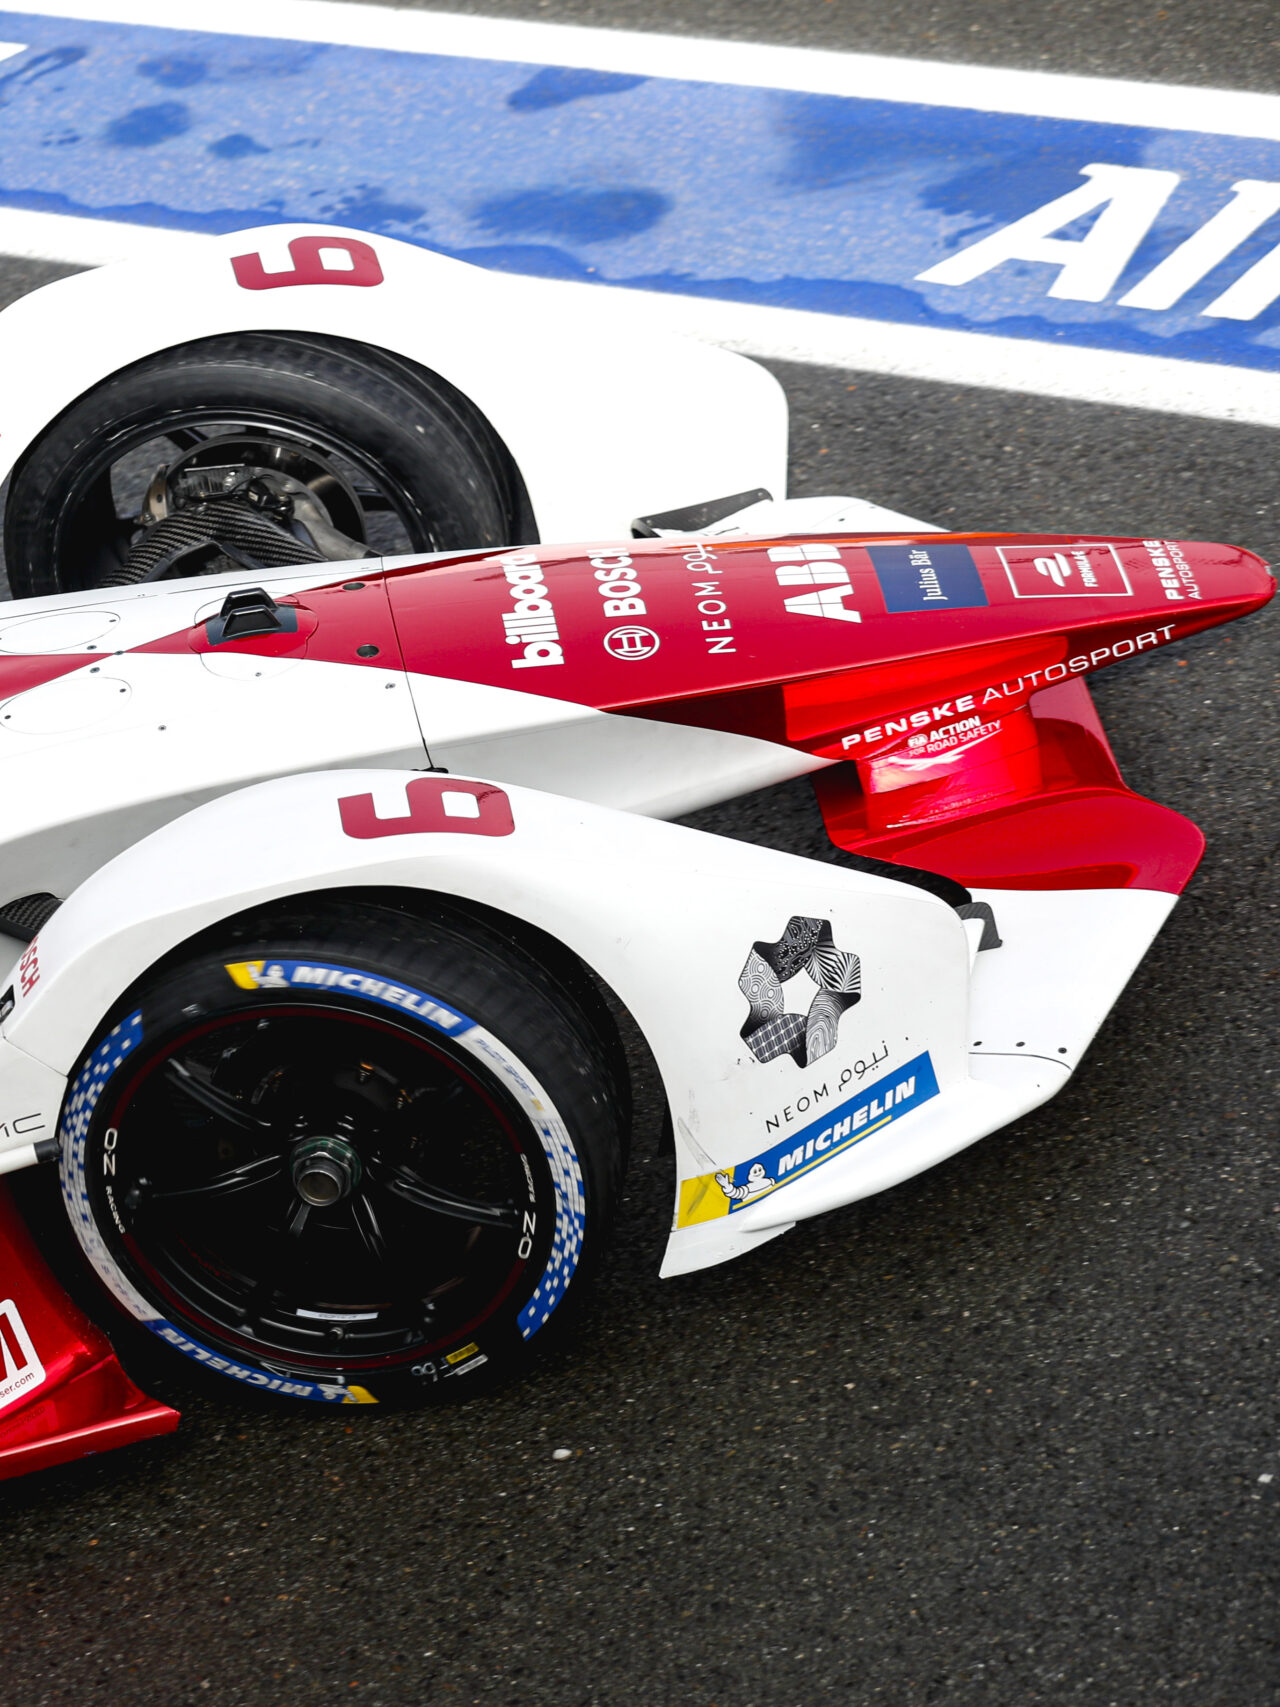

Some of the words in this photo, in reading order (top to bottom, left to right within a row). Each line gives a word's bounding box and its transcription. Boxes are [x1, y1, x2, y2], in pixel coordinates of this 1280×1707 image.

[230, 236, 384, 291] 6
[586, 548, 648, 617] BOSCH
[767, 543, 862, 623] ABB
[911, 549, 939, 567] Bär
[919, 566, 948, 601] Julius
[1142, 540, 1185, 600] PENSKE
[1164, 540, 1203, 600] AUTOSPORT
[500, 553, 565, 668] billboard
[691, 582, 736, 654] NEOM
[841, 695, 976, 750] PENSKE
[982, 623, 1177, 705] AUTOSPORT
[909, 746, 926, 757] FOR
[926, 737, 958, 753] ROAD
[958, 720, 1001, 743] SAFETY
[929, 715, 981, 742] ACTION
[337, 777, 515, 839] 6
[291, 965, 463, 1029] MICHELIN
[765, 1083, 830, 1134] NEOM
[838, 1039, 890, 1093] نيوم
[777, 1076, 916, 1177] MICHELIN
[105, 1185, 126, 1234] RACING
[157, 1327, 315, 1398] MICHELIN
